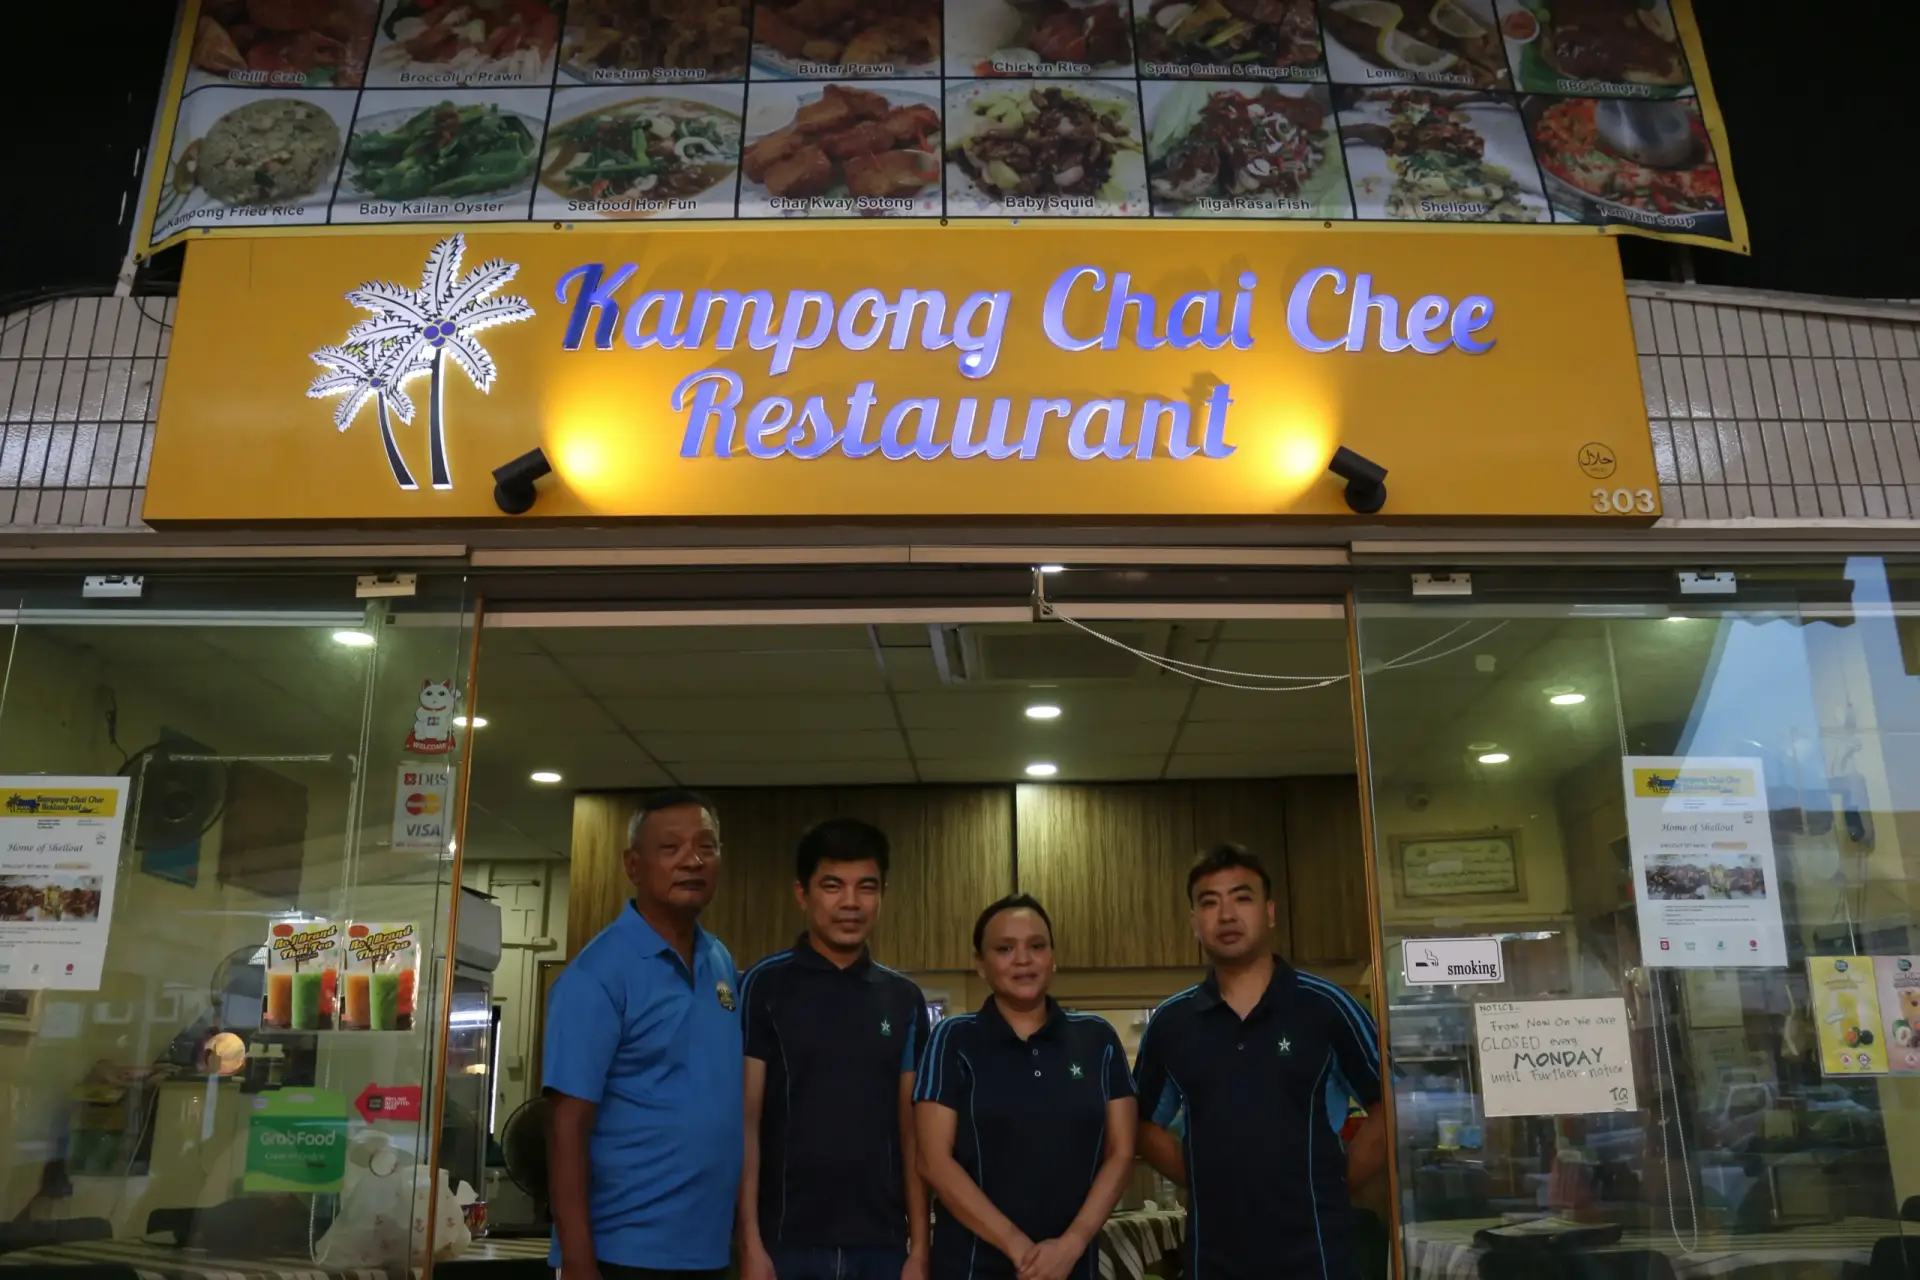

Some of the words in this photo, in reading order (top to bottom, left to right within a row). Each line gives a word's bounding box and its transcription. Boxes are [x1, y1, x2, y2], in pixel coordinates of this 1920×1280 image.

[400, 67, 458, 82] Broccoli
[477, 67, 522, 81] Prawn
[593, 68, 649, 80] Nestum
[653, 67, 707, 80] Sotong
[799, 63, 845, 75] Butter
[848, 62, 894, 73] Prawn
[993, 62, 1054, 74] Chicken
[1056, 62, 1092, 73] Rice
[1145, 62, 1190, 77] Spring
[1190, 63, 1232, 75] Onion
[1233, 64, 1244, 75] &
[1245, 64, 1290, 79] Ginger
[229, 205, 270, 218] Fried
[272, 203, 305, 216] Rice
[359, 203, 397, 217] Baby
[401, 202, 449, 215] Kailan
[453, 201, 505, 216] Oyster
[567, 198, 631, 212] Seafood
[635, 199, 664, 211] Hor
[668, 198, 698, 210] Fun
[769, 196, 807, 209] Char
[811, 196, 854, 211] Kway
[857, 196, 914, 210] Sotong
[1005, 196, 1045, 210] Baby
[1048, 196, 1095, 210] Squid
[1199, 197, 1231, 211] Tiga
[1235, 198, 1273, 210] Rasa
[1277, 199, 1310, 210] Fish
[1420, 201, 1483, 213] Shellout
[555, 262, 1012, 379] Kampong
[1042, 265, 1257, 351] Chai
[1286, 265, 1497, 354] Chee
[671, 367, 1237, 461] Restaurant
[1591, 488, 1656, 514] 303
[407, 824, 441, 837] VISA
[1660, 823, 1686, 832] Home
[1689, 823, 1698, 833] of
[1700, 823, 1735, 832] Shellout
[6, 843, 33, 852] Home
[36, 844, 46, 854] of
[48, 843, 84, 852] Shellout
[299, 924, 338, 945] Brand
[374, 924, 413, 945] Brand
[280, 945, 310, 961] Thai
[309, 940, 335, 952] Tea
[356, 945, 389, 962] Thai
[386, 940, 412, 953] Tea
[1447, 960, 1498, 978] smoking
[1490, 1020, 1520, 1032] From
[1526, 1018, 1550, 1029] Now
[1595, 1016, 1617, 1026] are
[1481, 1036, 1541, 1052] CLOSED
[1549, 1036, 1579, 1047] every
[1513, 1047, 1604, 1070] MONDAY
[1588, 1063, 1624, 1078] notice
[1609, 1086, 1629, 1101] TQ
[260, 1130, 336, 1146] GrabFood
